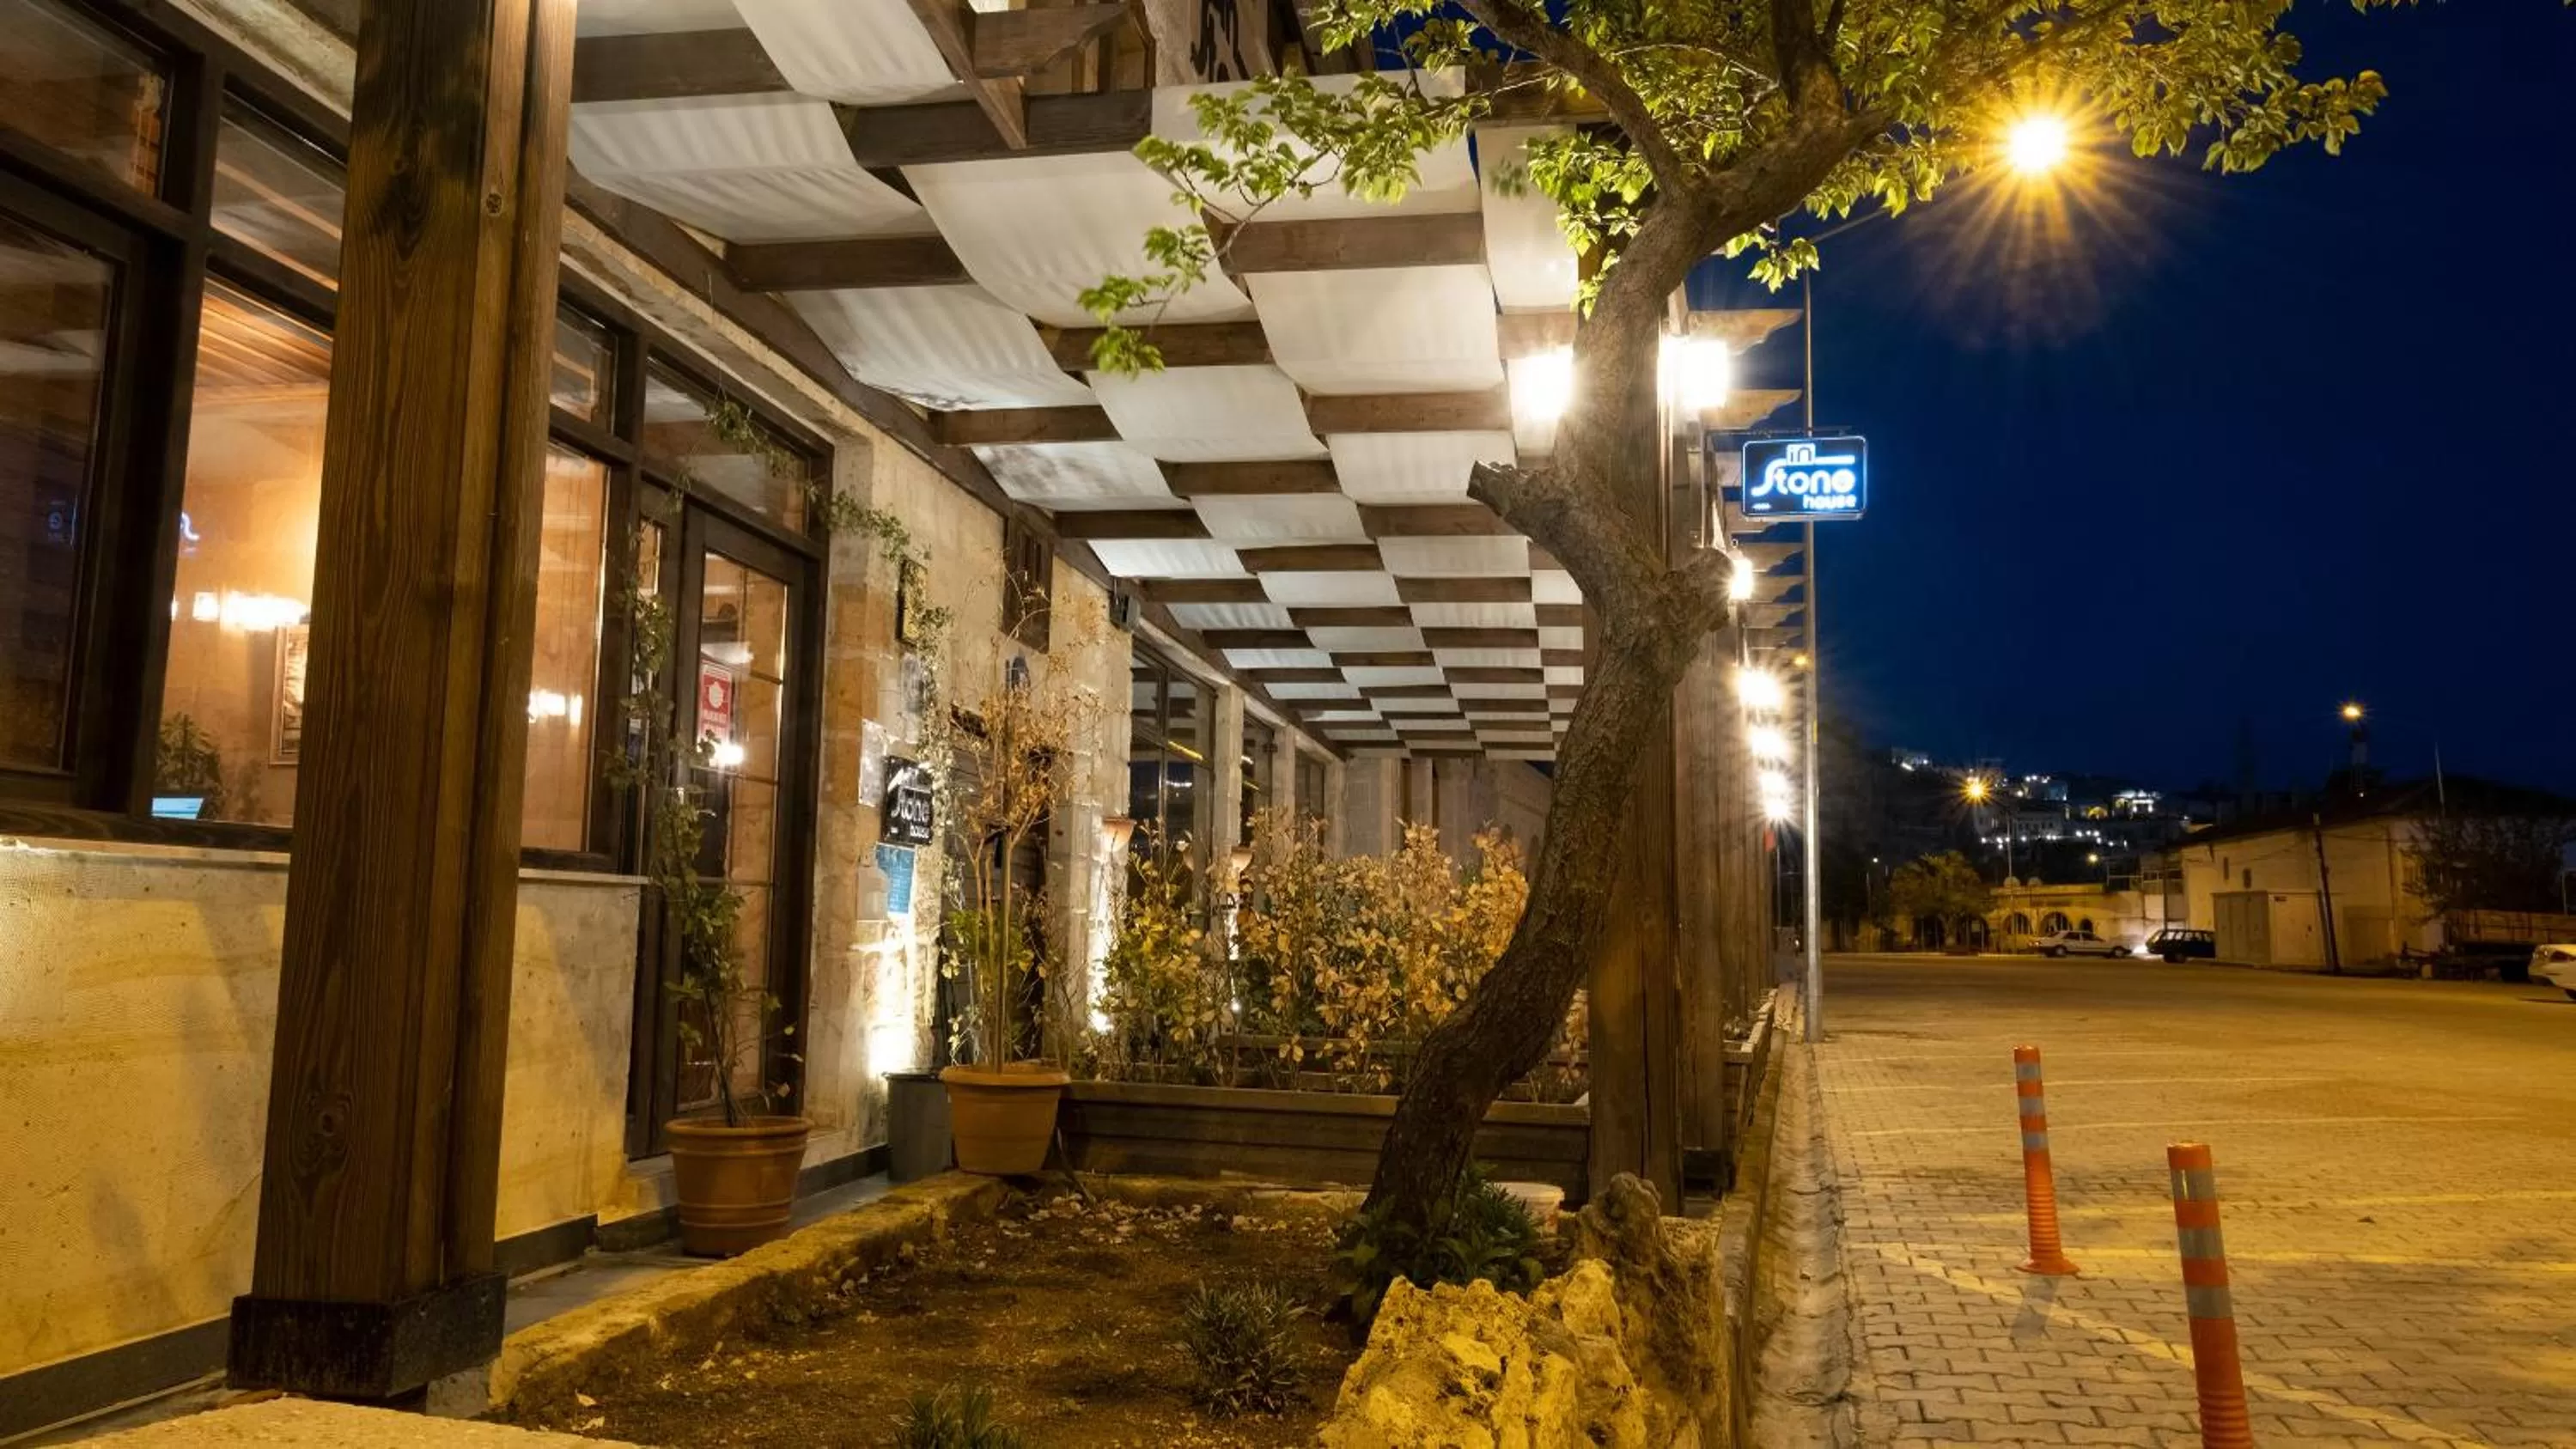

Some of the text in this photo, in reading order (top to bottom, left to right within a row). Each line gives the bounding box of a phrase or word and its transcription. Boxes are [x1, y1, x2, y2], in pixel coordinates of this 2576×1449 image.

[1788, 447, 1813, 463] in
[1751, 455, 1855, 496] Stone
[1803, 495, 1857, 509] house
